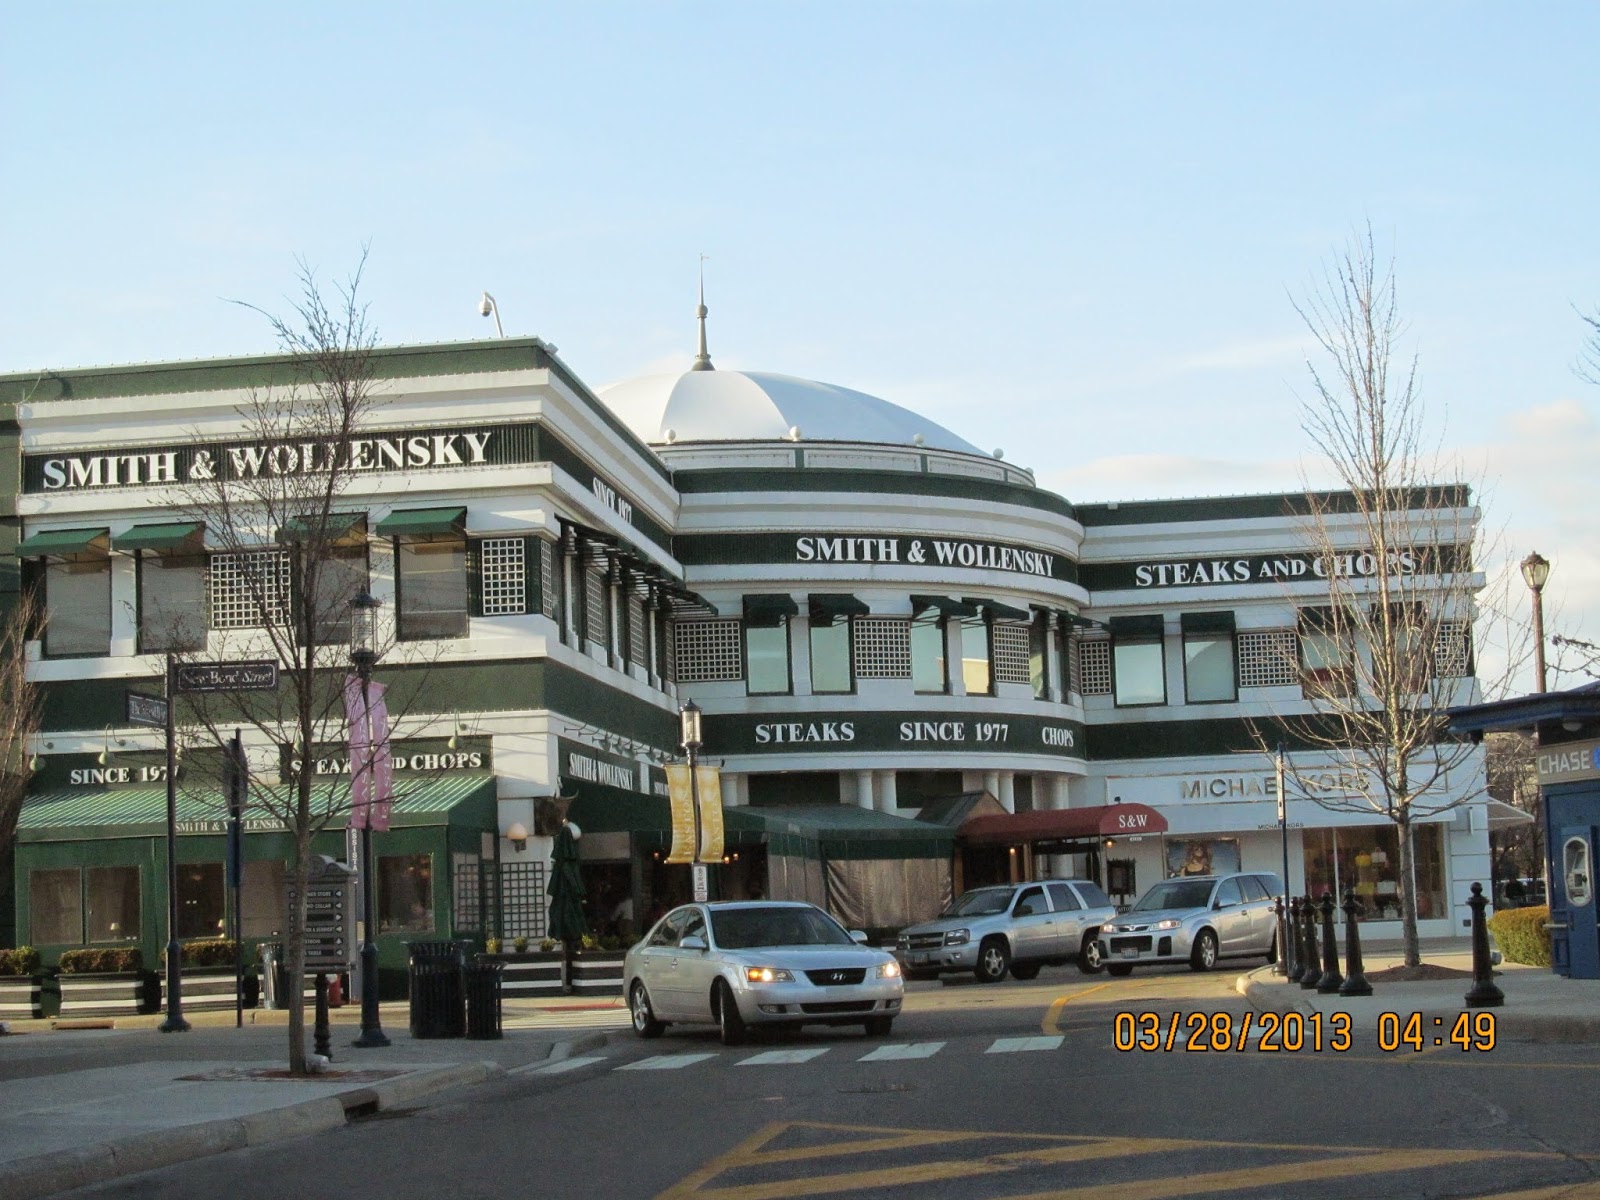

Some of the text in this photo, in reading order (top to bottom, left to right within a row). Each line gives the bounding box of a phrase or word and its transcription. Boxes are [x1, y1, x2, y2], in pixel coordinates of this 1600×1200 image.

[43, 432, 492, 490] SMITH & WOLLENSKY
[796, 537, 1054, 577] SMITH & WOLLENSKY
[1135, 559, 1251, 587] STEAKS
[1258, 559, 1306, 578] AND
[755, 722, 855, 743] STEAKS
[900, 722, 1009, 742] SINCE 1977
[1041, 727, 1074, 747] CHOPS
[410, 752, 483, 770] CHOPS
[1538, 750, 1591, 774] CHASE
[70, 767, 131, 785] SINCE
[1302, 772, 1370, 793] KORS
[175, 819, 286, 833] SMITH & LENSKY
[1118, 814, 1148, 829] S&W
